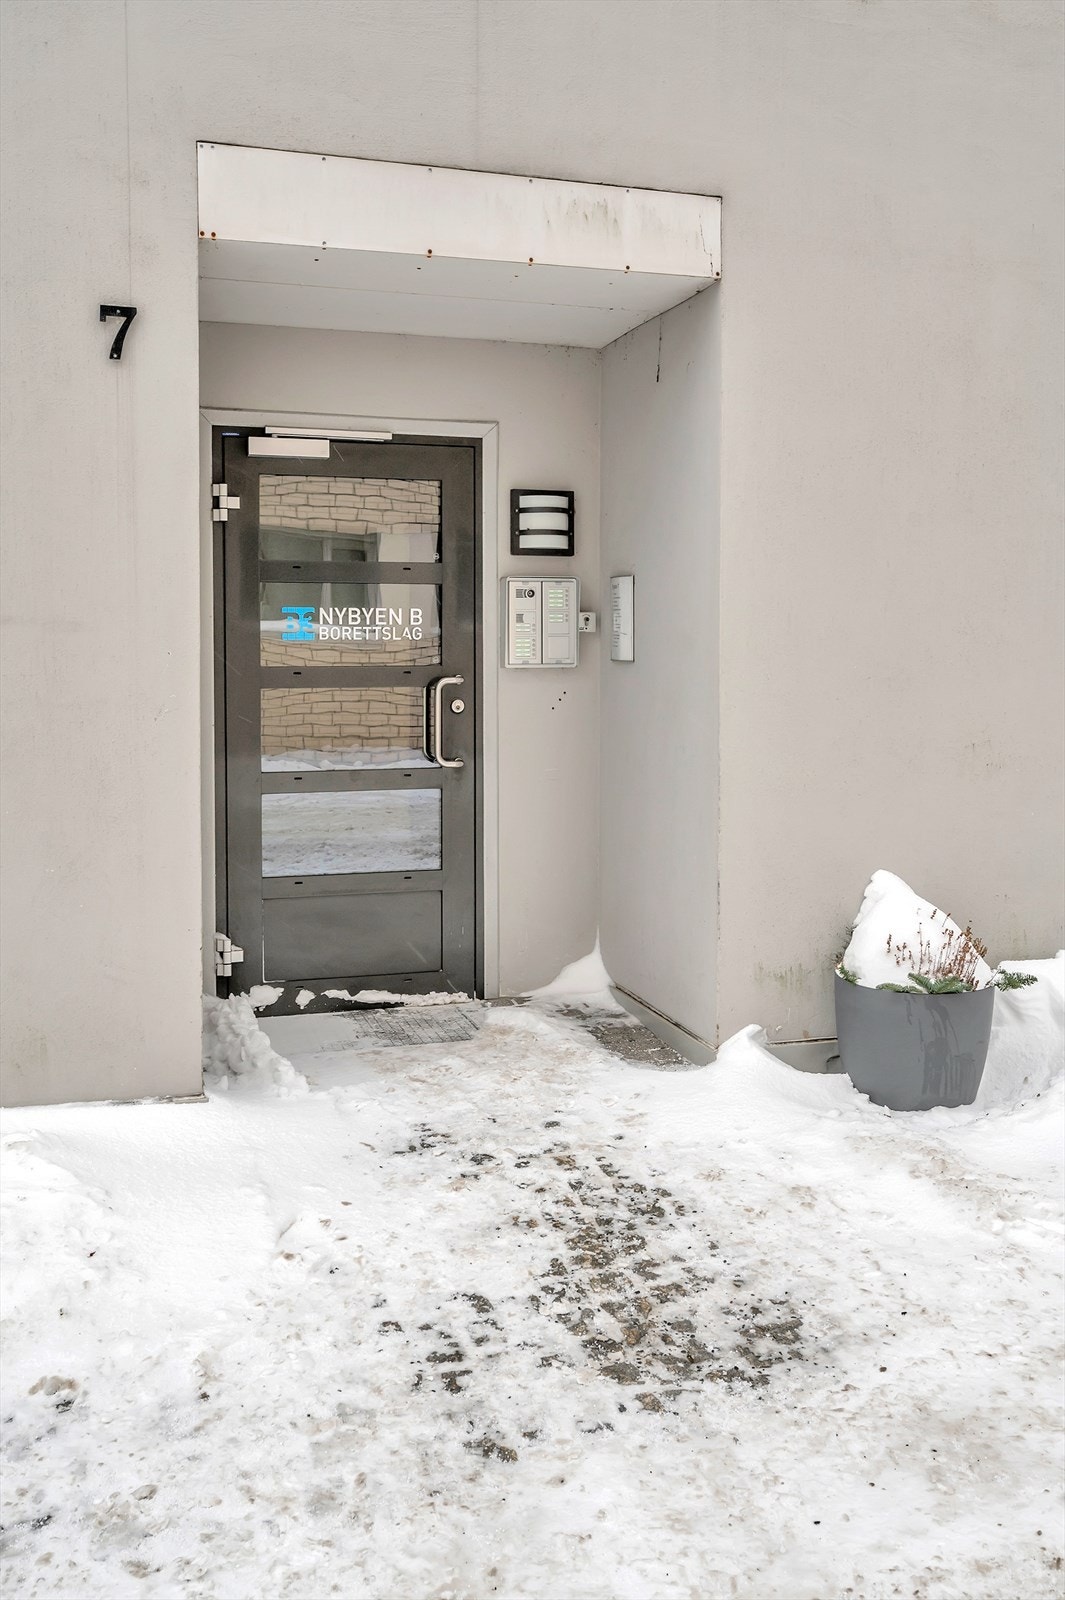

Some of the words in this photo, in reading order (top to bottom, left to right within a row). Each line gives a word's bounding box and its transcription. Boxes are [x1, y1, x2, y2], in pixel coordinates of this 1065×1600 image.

[99, 304, 137, 360] 7
[319, 607, 403, 625] NYBYEN
[410, 608, 423, 625] B
[319, 626, 423, 641] BORETTSLAG
